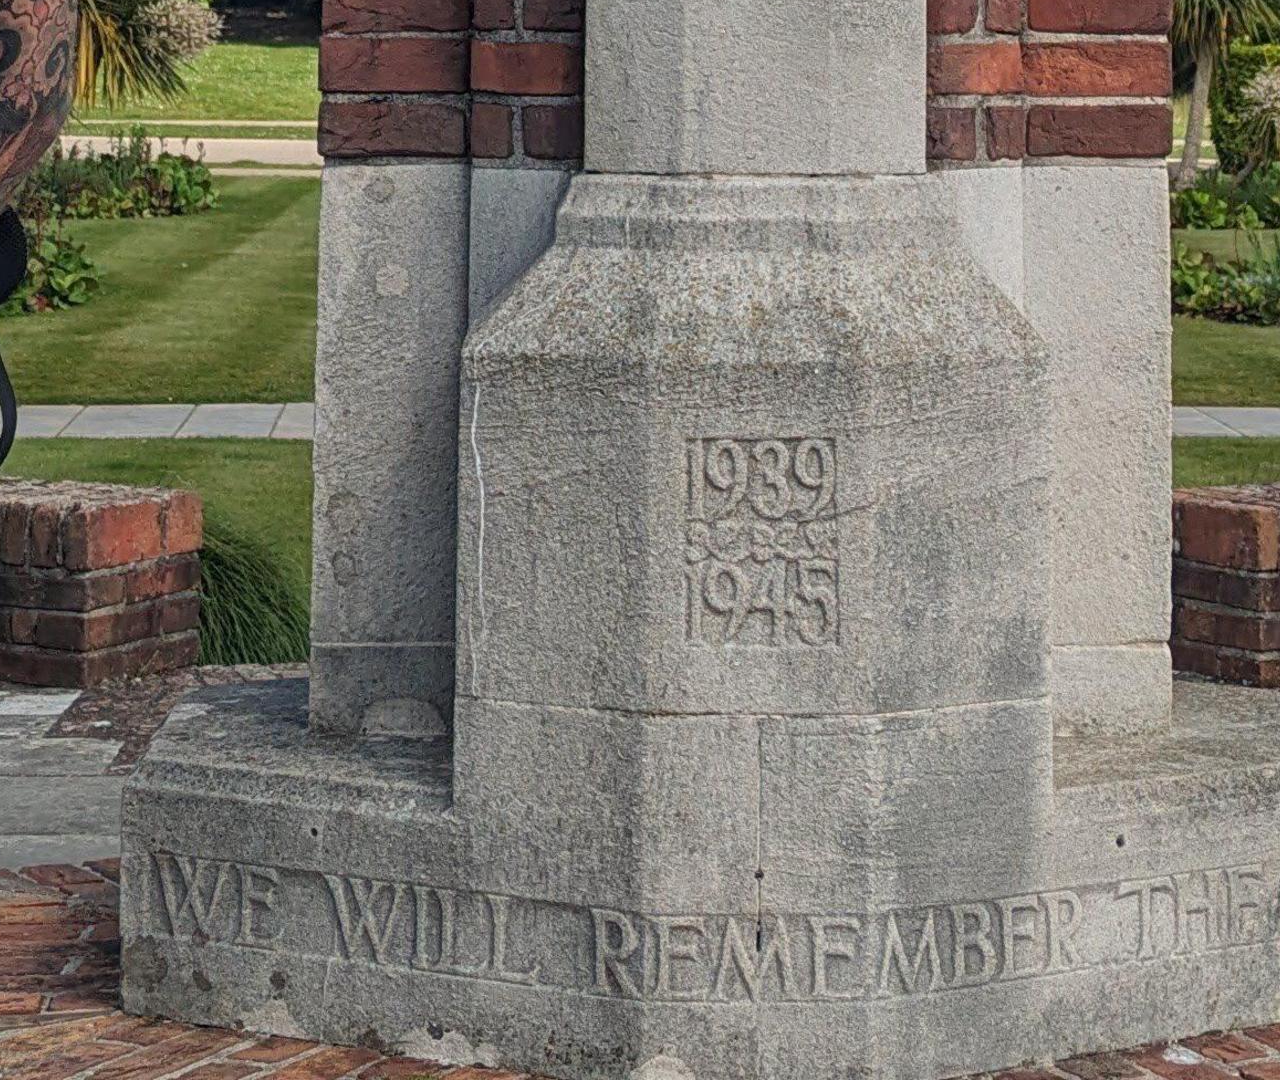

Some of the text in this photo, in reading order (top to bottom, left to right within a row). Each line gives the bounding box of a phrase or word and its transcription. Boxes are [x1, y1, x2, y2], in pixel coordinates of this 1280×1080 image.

[687, 439, 835, 520] 1939
[686, 562, 838, 644] 1945
[151, 851, 282, 950] WE
[322, 874, 540, 986] WILL
[589, 890, 1086, 1002] REMEMBER
